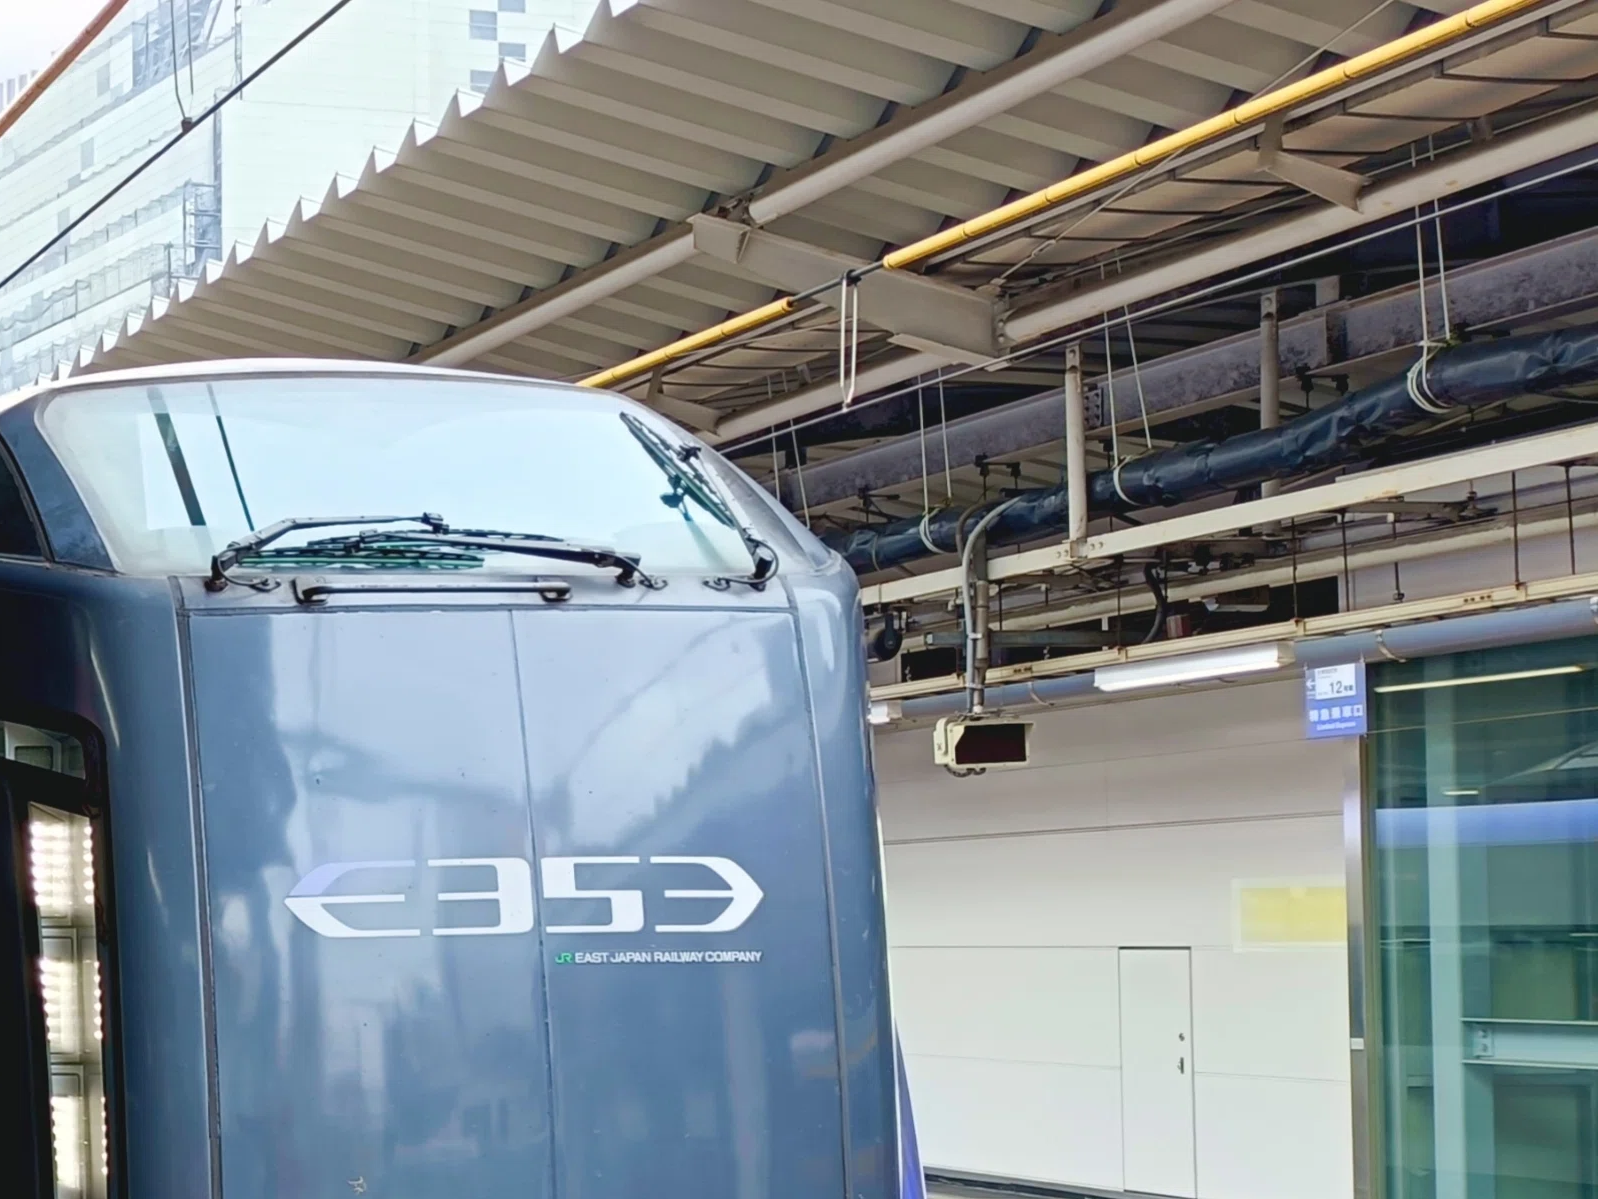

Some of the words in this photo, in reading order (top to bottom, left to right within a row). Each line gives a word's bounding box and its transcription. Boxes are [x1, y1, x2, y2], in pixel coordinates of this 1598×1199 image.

[284, 856, 764, 938] E353
[555, 953, 573, 964] JR
[575, 952, 609, 964] EAST
[610, 952, 652, 964] JAPAN
[654, 952, 703, 963] RAILWAY
[705, 951, 762, 962] COMPANY
